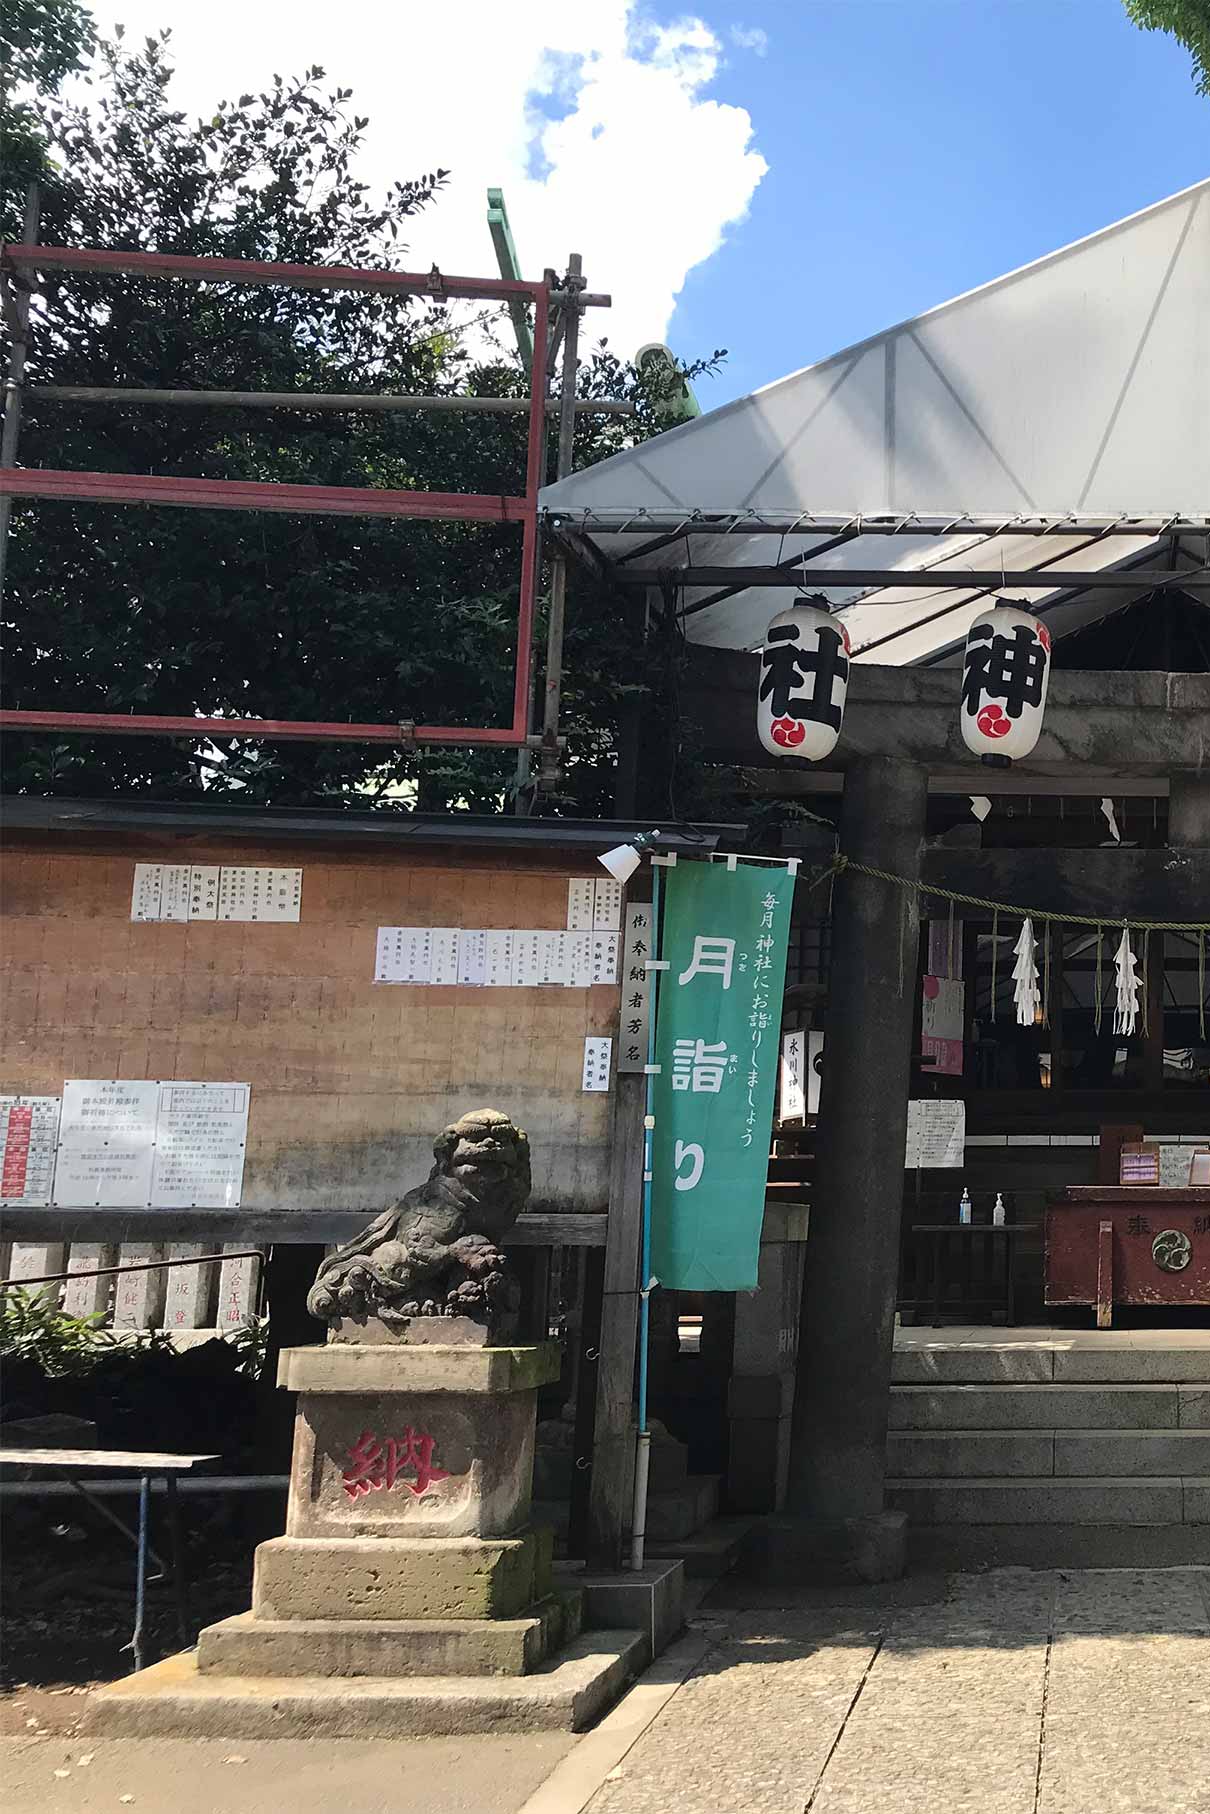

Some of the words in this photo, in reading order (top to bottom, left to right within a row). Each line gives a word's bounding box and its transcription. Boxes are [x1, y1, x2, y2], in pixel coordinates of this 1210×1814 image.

[760, 623, 849, 734] 社
[962, 623, 1047, 719] 神
[671, 934, 737, 1192] 月詣り
[343, 1423, 452, 1504] 納
